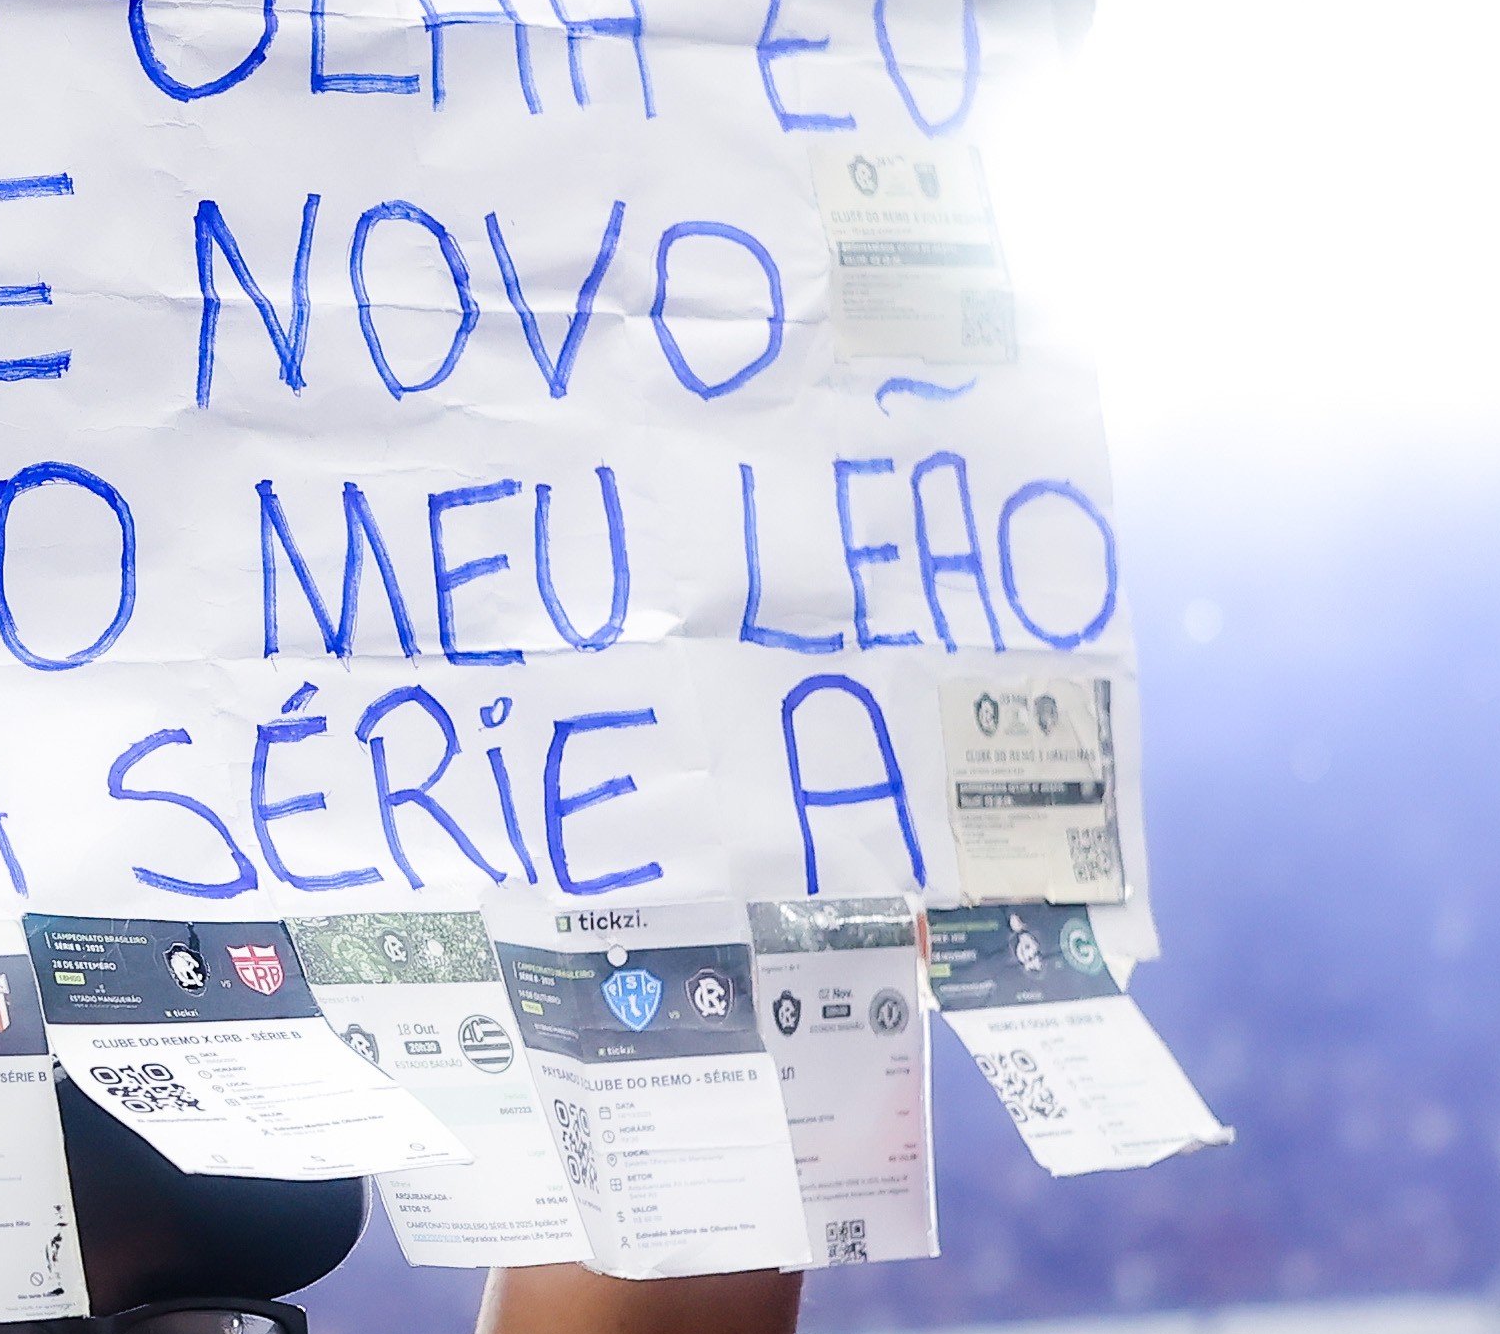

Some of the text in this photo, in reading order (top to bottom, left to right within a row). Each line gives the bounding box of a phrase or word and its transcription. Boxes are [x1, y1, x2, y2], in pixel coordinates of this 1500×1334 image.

[194, 193, 784, 407] NOVO
[255, 466, 630, 666] MEU
[740, 375, 1117, 654] LEÃO
[782, 674, 926, 895] A
[578, 909, 648, 932] tickzi.
[92, 1037, 139, 1049] CLUBE
[139, 1036, 159, 1048] DO
[160, 1034, 200, 1047] REMO
[202, 1033, 212, 1045] X
[212, 1032, 243, 1045] CRB
[251, 1030, 291, 1042] SÉRIE
[397, 1022, 440, 1036] 18 Out.
[0, 1070, 36, 1084] SÉRIE
[38, 1071, 48, 1083] B
[626, 1076, 648, 1090] DO
[651, 1072, 692, 1088] REMO
[703, 1068, 744, 1085] SÉRIE
[747, 1068, 758, 1082] B
